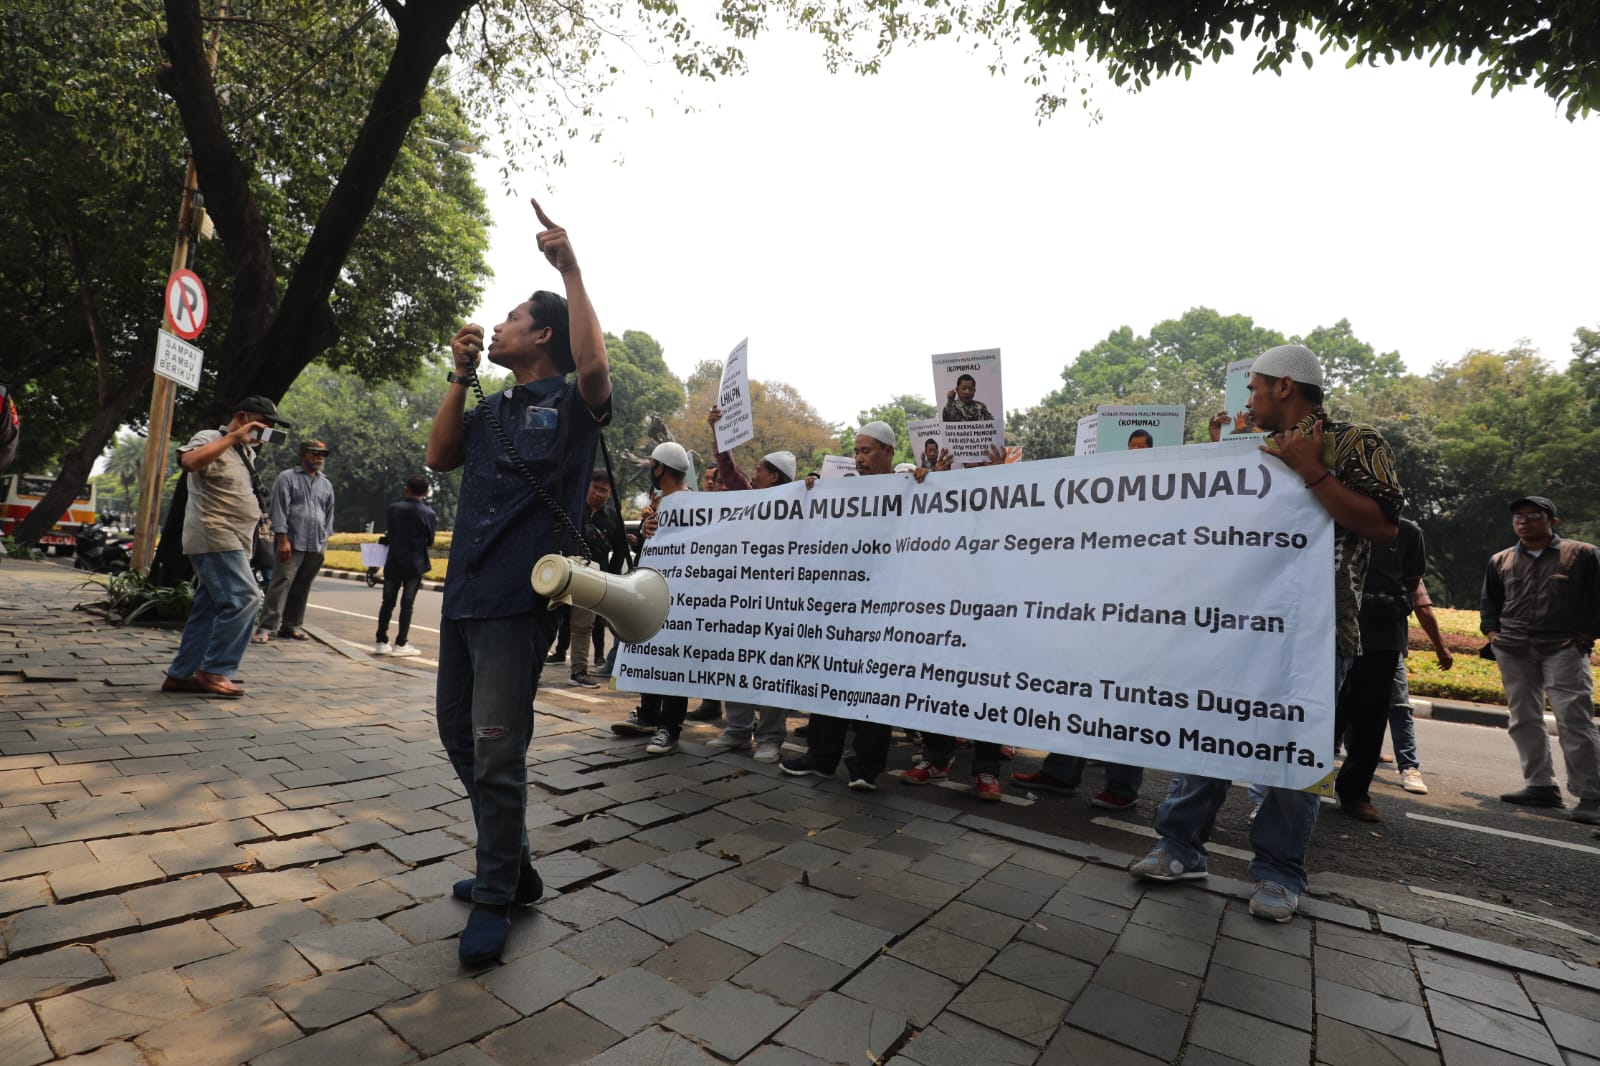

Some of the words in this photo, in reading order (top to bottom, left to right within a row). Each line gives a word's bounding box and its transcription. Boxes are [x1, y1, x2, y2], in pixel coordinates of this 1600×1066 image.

[164, 350, 195, 372] RAMBU
[165, 339, 197, 360] SAMPAI
[159, 358, 197, 383] BERIKUT
[946, 363, 981, 373] (KOMUNAL)
[1118, 419, 1161, 428] (KOMUNAL)
[718, 499, 804, 523] PEMUDA
[809, 494, 903, 519] MUSLIM
[910, 482, 1046, 515] NASIONAL
[1053, 463, 1272, 509] (KOMUNAL)
[690, 541, 738, 559] Dengan
[741, 541, 785, 558] Tegas
[788, 539, 849, 555] Presiden
[851, 539, 892, 555] Joko
[895, 536, 951, 554] Widodo
[954, 535, 1000, 555] Agar
[1003, 534, 1075, 555] Segera
[1080, 529, 1187, 550] Memecat
[1193, 526, 1308, 549] Suharso
[684, 565, 738, 582] Sebagai
[740, 567, 795, 581] Menteri
[797, 566, 871, 584] Bapennas.
[677, 593, 727, 610] Kepada
[730, 595, 762, 610] Polri
[765, 597, 805, 612] Untuk
[806, 597, 857, 616] Segera
[860, 598, 946, 616] Memproses
[949, 599, 1018, 620] Dugaan
[1023, 600, 1096, 622] Tindak
[1101, 602, 1187, 626] Pidana
[1194, 606, 1285, 634] Ujaran
[695, 618, 762, 638] Terhadap
[764, 621, 795, 640] Kyai
[797, 623, 823, 640] Oleh
[825, 625, 881, 642] Suharso
[883, 626, 967, 648] Monoarfa.
[623, 642, 680, 658] Mendesak
[683, 645, 735, 662] Kepada
[738, 648, 767, 665] BPK
[769, 651, 794, 668] dan
[796, 653, 821, 671] KPK
[823, 656, 864, 675] Untuk
[865, 659, 917, 679] Segera
[920, 663, 1012, 689] Mengusut
[1015, 671, 1094, 698] Secara
[1099, 679, 1190, 709] Tuntas
[1196, 689, 1305, 723] Dugaan
[619, 663, 686, 683] Pemalsuan
[688, 670, 736, 687] LHKPN
[738, 674, 749, 689] &
[752, 676, 819, 698] Gratifikasi
[820, 683, 901, 708] Penggunaan
[904, 692, 970, 718] Private
[973, 702, 1009, 724] Jet
[1013, 706, 1061, 732] Oleh
[1066, 713, 1172, 746] Suharso
[1178, 727, 1325, 769] Manoarfa.
